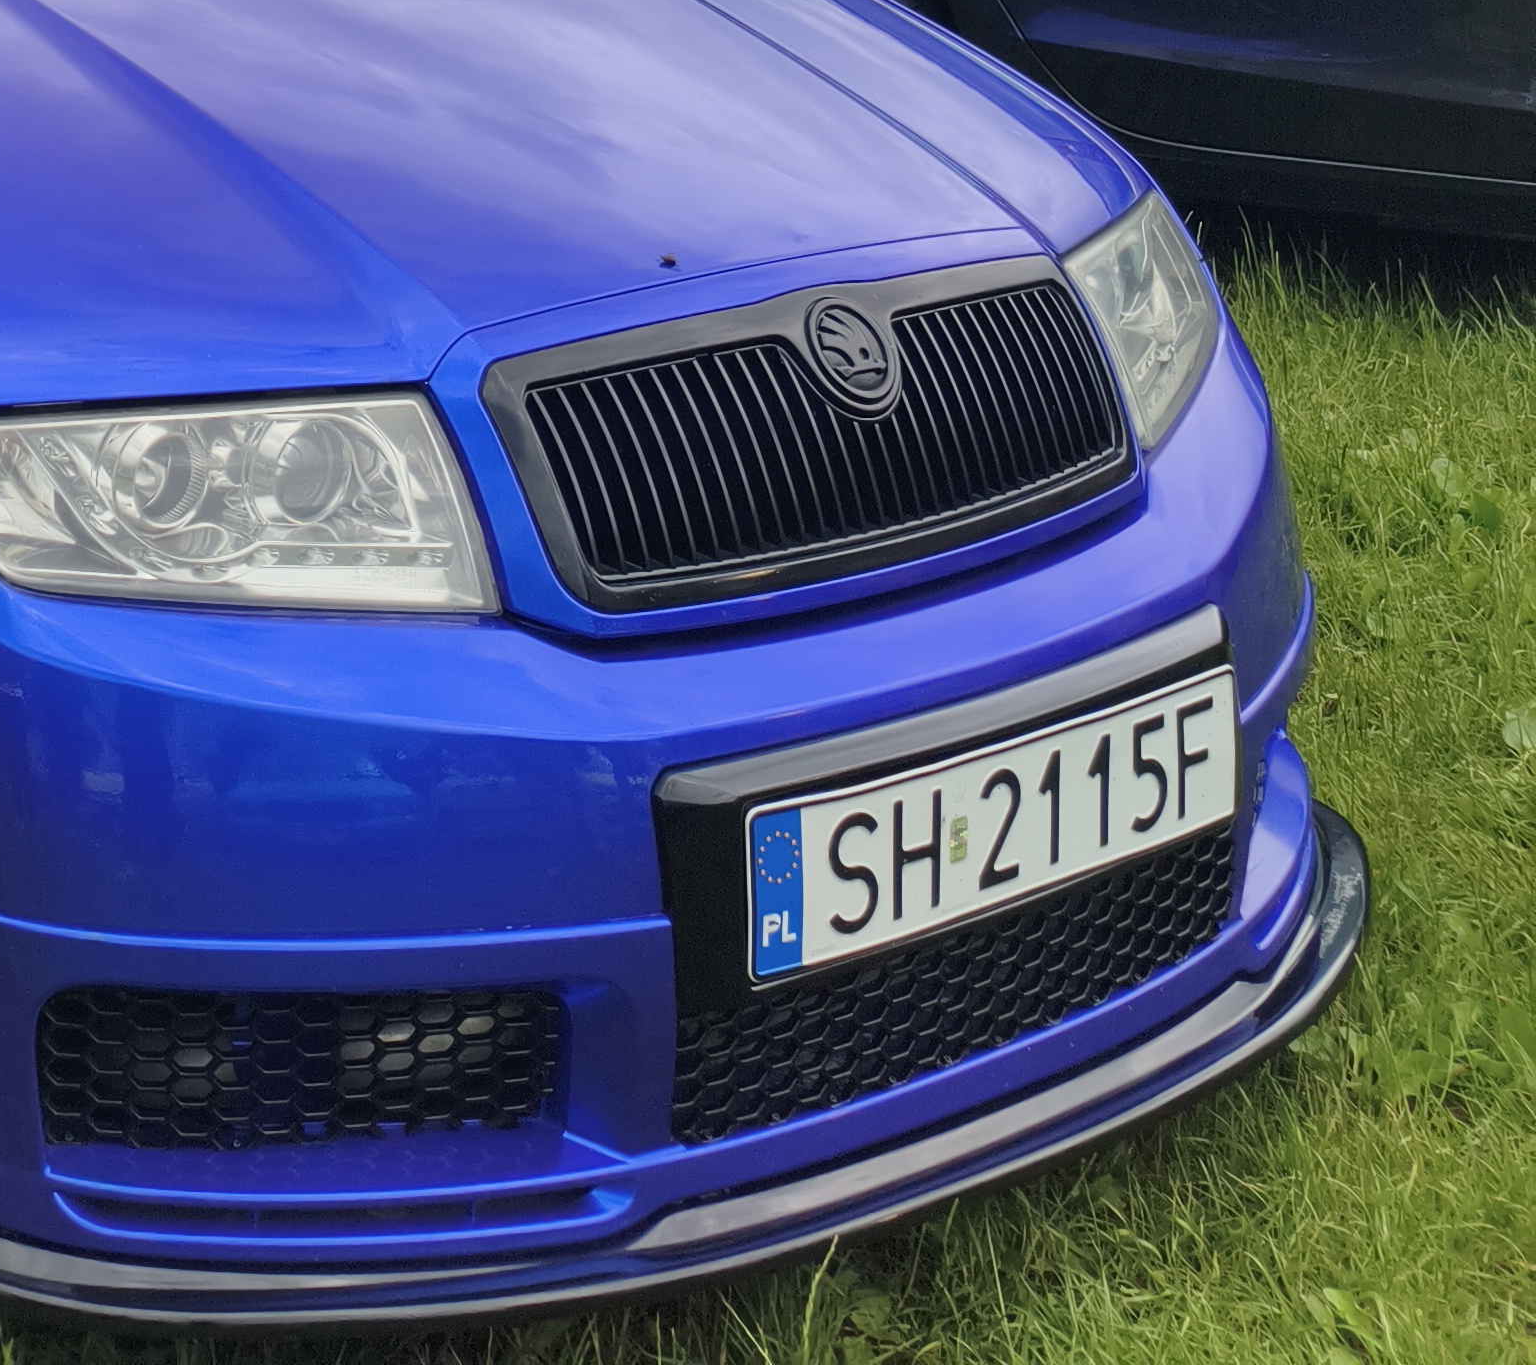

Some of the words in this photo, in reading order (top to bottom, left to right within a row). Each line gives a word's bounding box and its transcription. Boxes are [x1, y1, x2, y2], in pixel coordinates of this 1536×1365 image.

[828, 788, 943, 934] SH
[978, 695, 1214, 891] 2115F
[761, 910, 797, 947] PL
